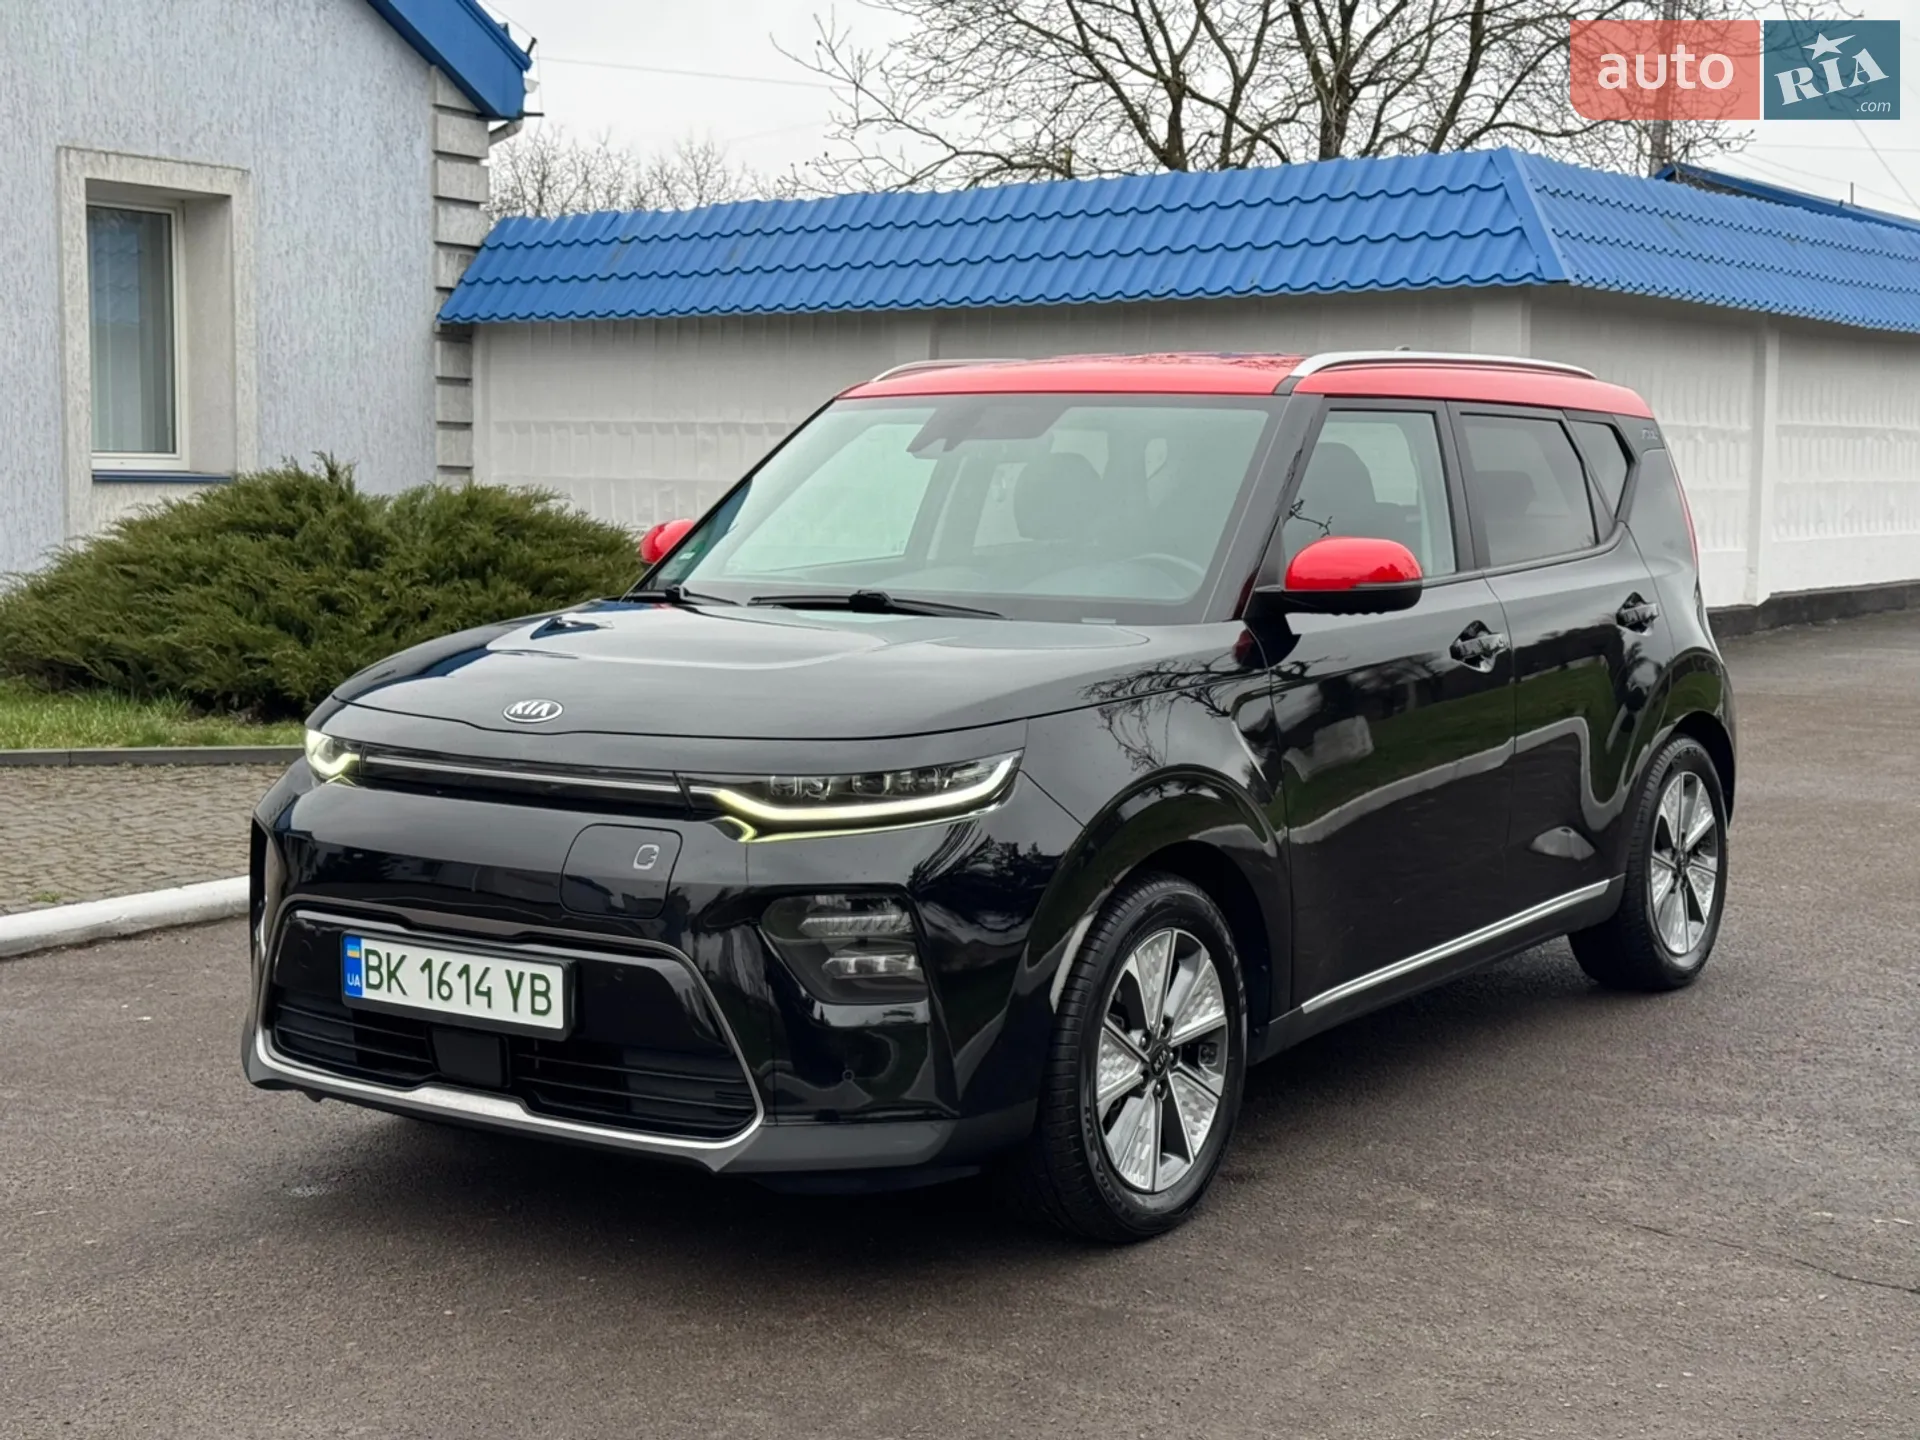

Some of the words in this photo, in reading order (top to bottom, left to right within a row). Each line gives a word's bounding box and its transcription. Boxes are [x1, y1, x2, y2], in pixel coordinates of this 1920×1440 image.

[509, 701, 551, 717] KIA
[346, 973, 361, 988] UA
[364, 947, 409, 997] BK
[419, 957, 493, 1010] 1614
[505, 969, 552, 1017] YB
[1153, 1049, 1168, 1072] KIA
